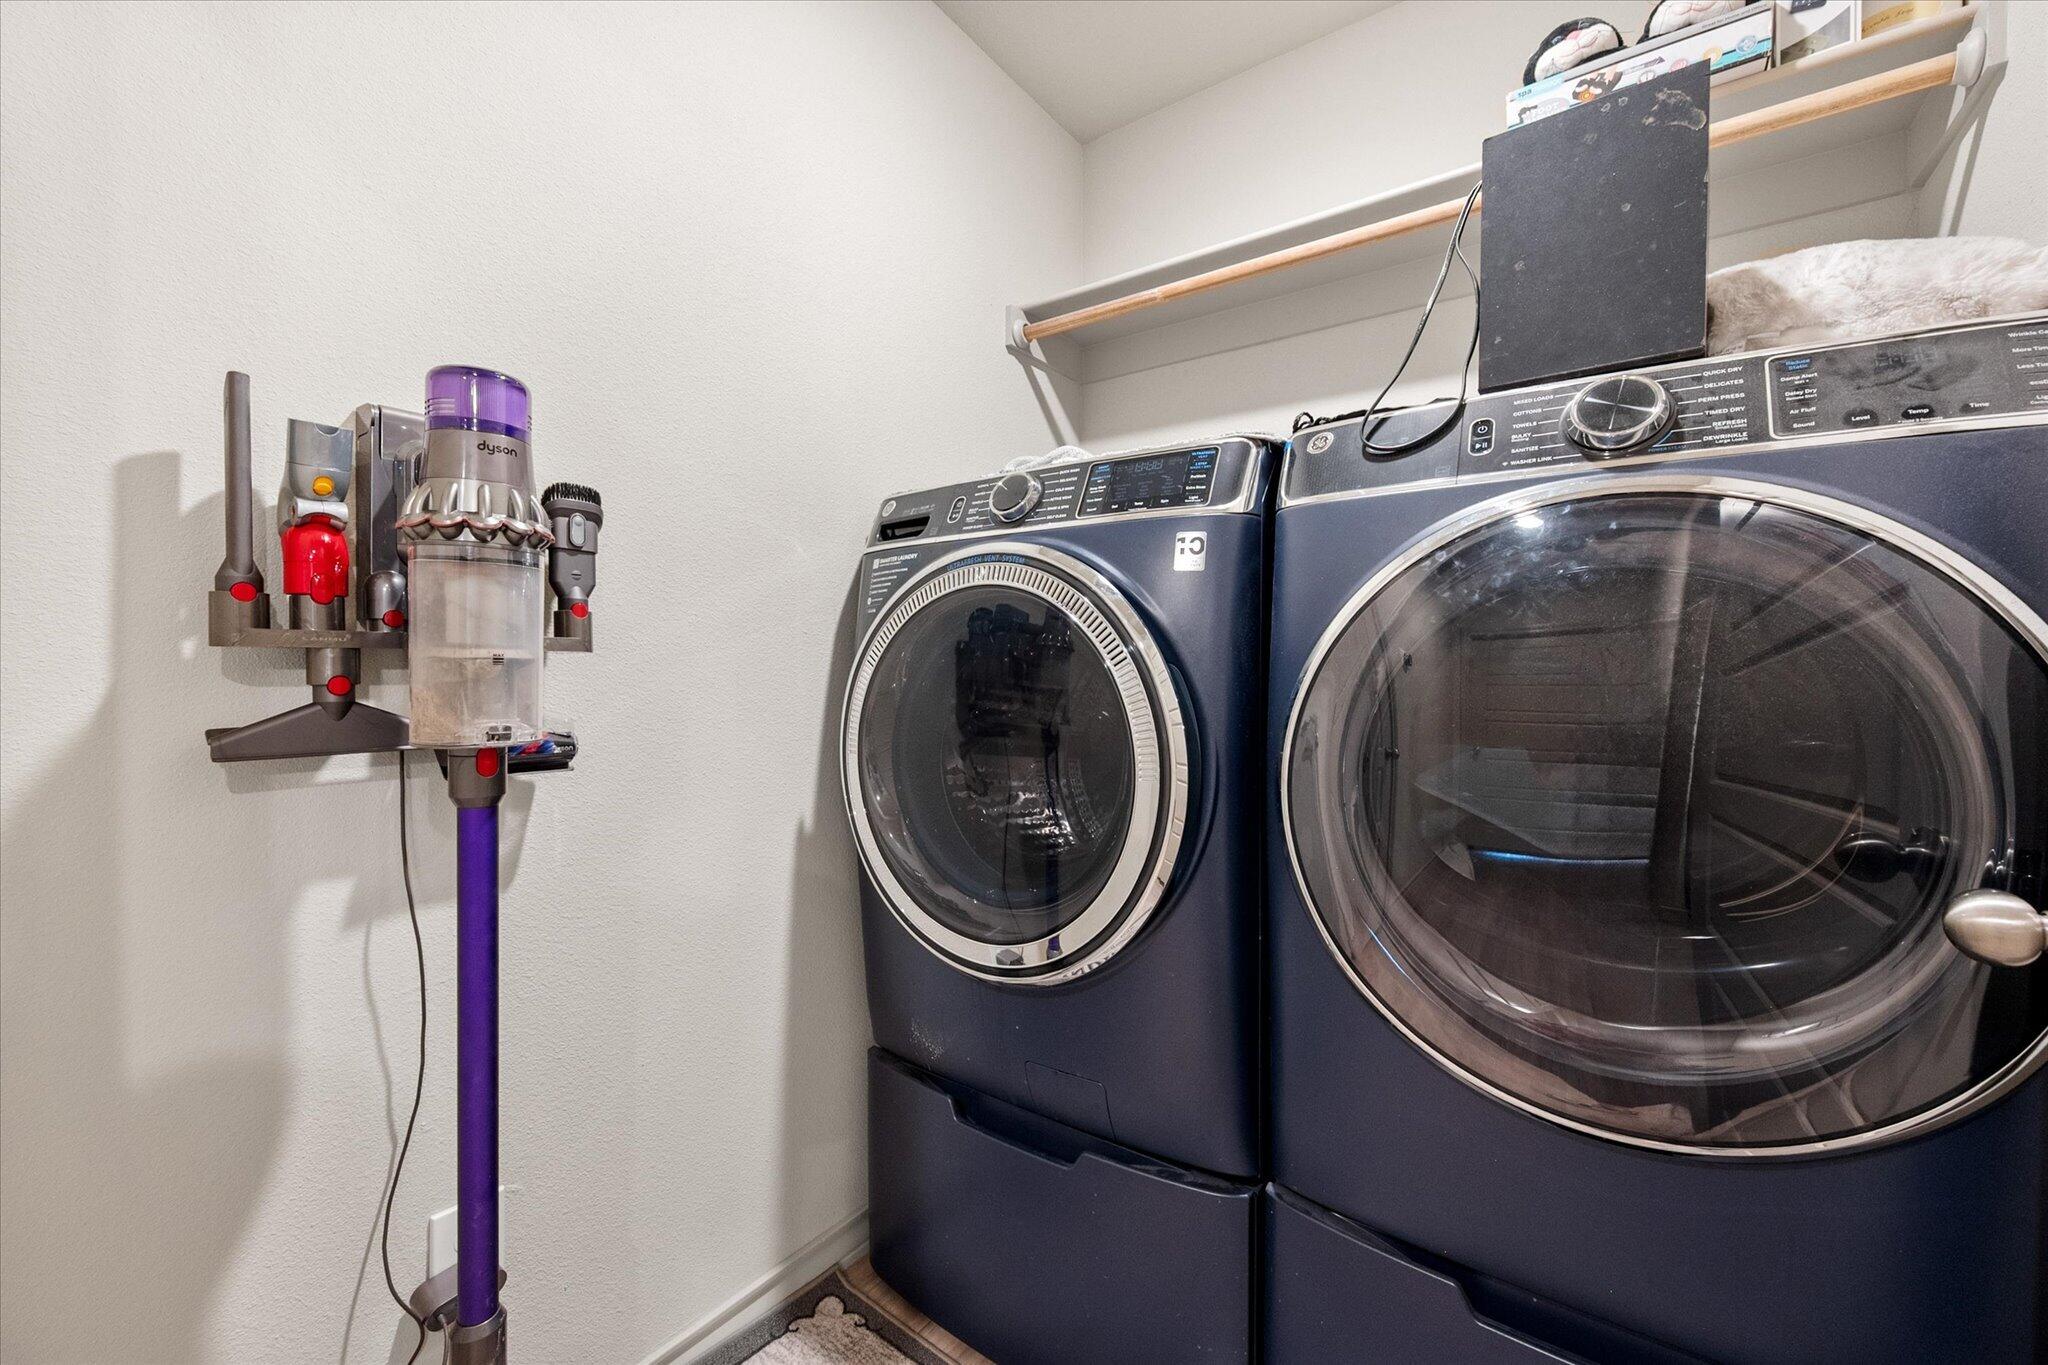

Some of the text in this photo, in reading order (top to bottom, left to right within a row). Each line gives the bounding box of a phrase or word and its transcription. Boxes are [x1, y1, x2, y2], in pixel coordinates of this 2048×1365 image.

[1518, 89, 1532, 98] spa
[1703, 368, 1726, 377] QUICK
[1704, 378, 1744, 389] DELICATES
[1720, 392, 1745, 400] PRESS
[1512, 408, 1542, 417] COTTONS
[1704, 408, 1728, 416] TIMED
[1512, 421, 1537, 429] TOWELS
[1712, 418, 1747, 427] REFRESH
[1792, 421, 1815, 429] Sound
[1703, 432, 1748, 441] DEWRINKLE
[477, 440, 518, 458] dyson
[1511, 445, 1539, 453] SANITIZE
[1510, 458, 1536, 466] WASHER
[897, 552, 919, 561] LAUNDRY
[984, 554, 999, 562] VENT
[1002, 554, 1025, 564] SYSTEM
